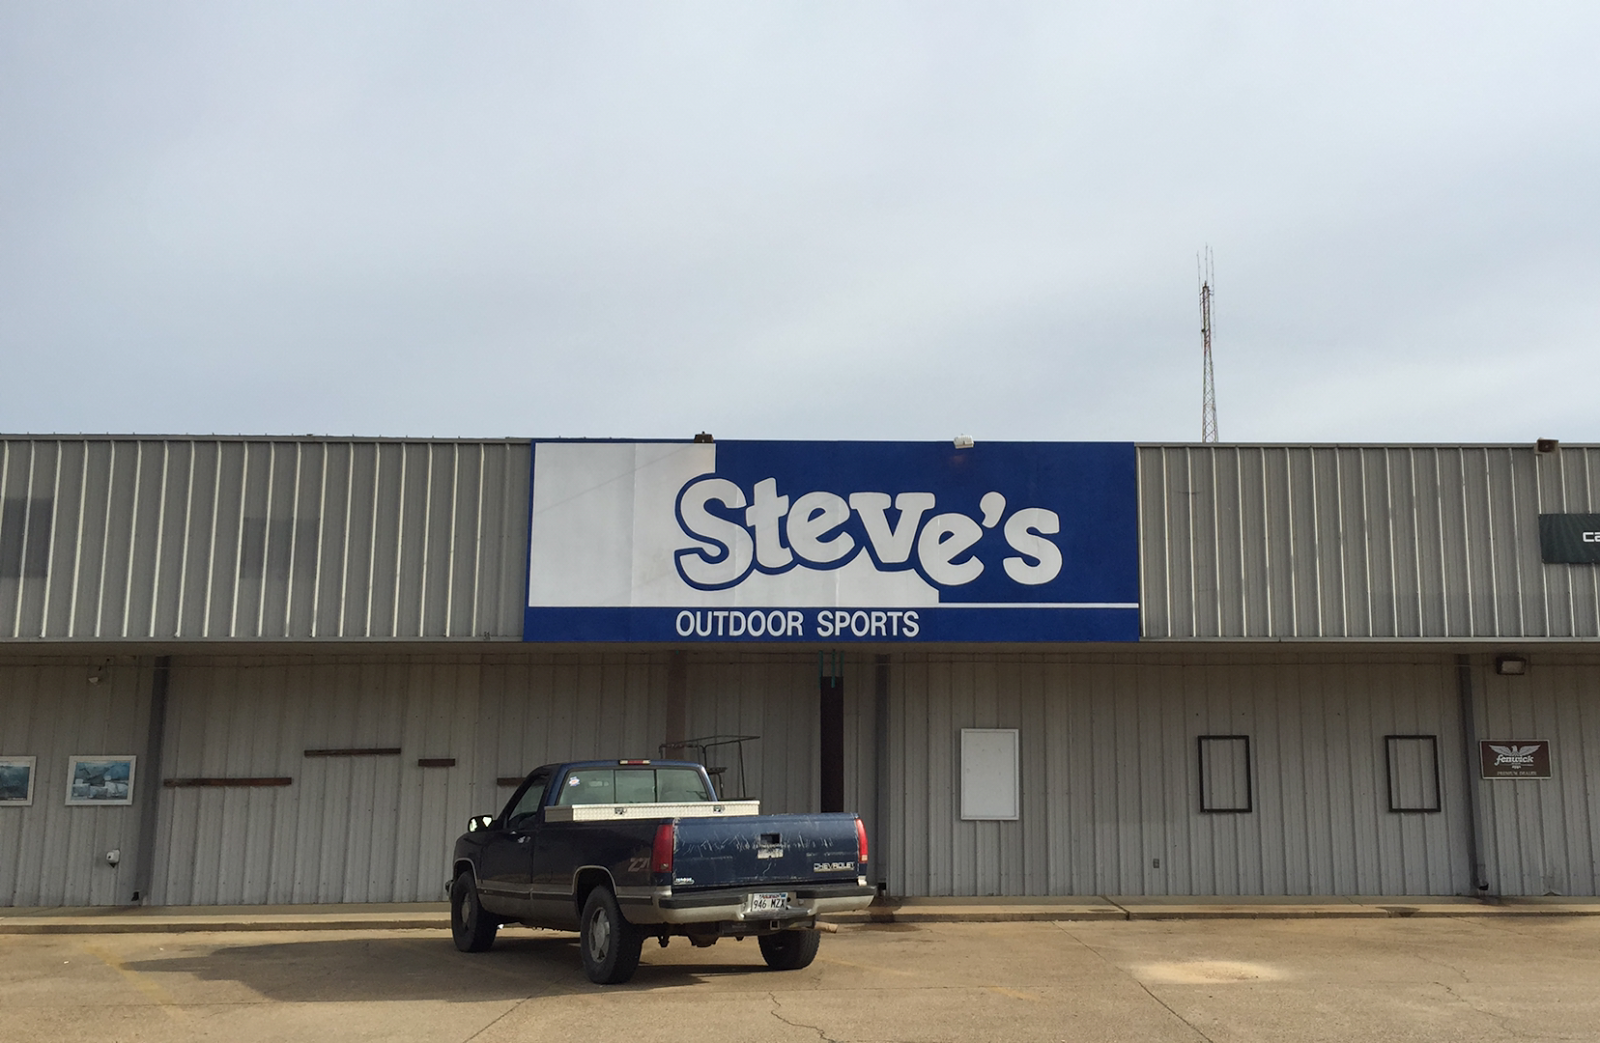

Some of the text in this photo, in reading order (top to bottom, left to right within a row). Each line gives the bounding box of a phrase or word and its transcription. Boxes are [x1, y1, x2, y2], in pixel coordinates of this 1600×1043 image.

[678, 477, 1063, 587] Steve's
[675, 609, 920, 638] OUTDOOR SPORTS
[813, 861, 855, 872] CHEVROLET
[753, 898, 786, 909] 946 MZX
